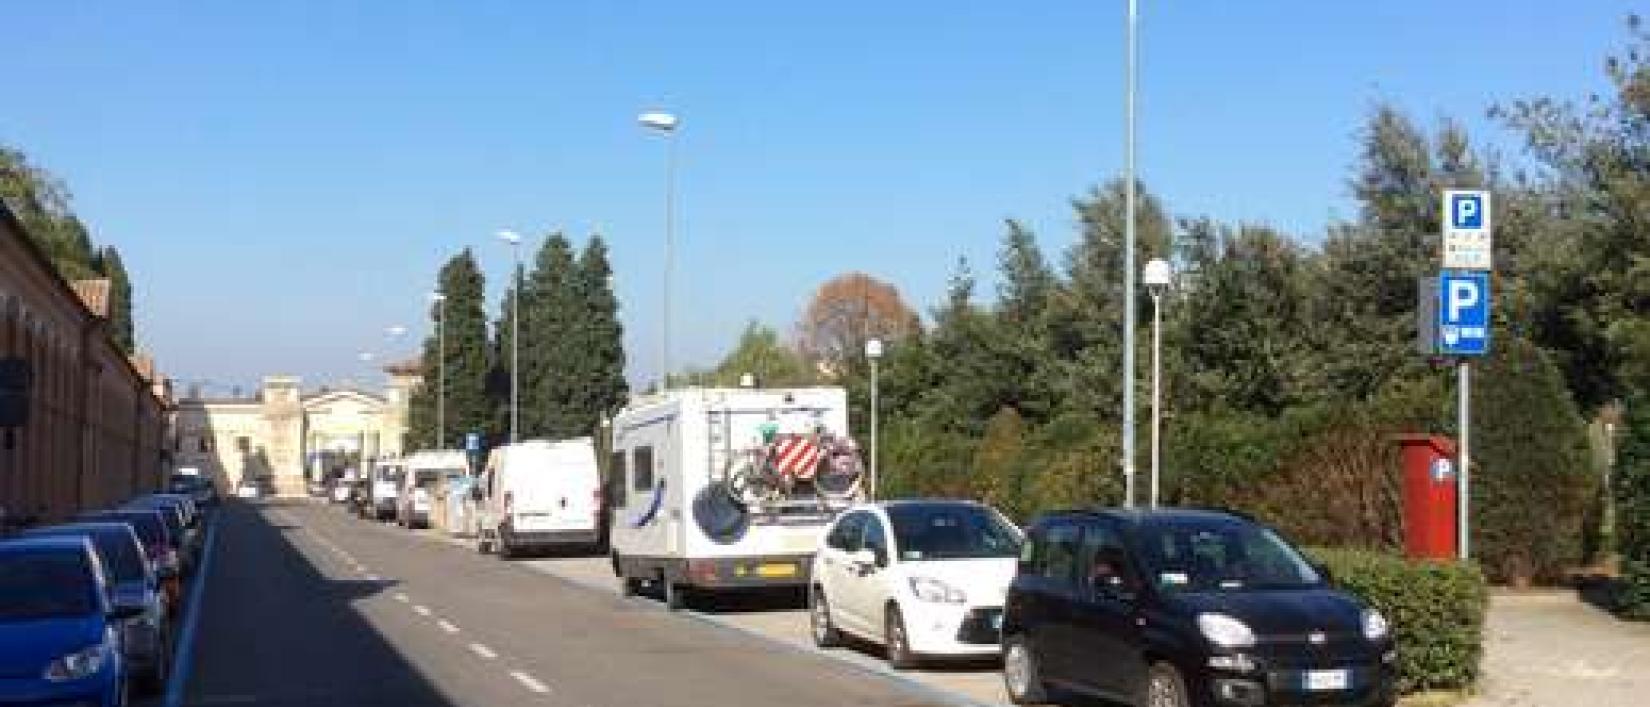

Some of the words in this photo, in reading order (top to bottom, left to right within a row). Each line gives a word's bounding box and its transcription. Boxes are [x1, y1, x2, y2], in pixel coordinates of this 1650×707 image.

[1458, 199, 1476, 223] P
[1449, 279, 1478, 322] P
[1436, 459, 1451, 480] P
